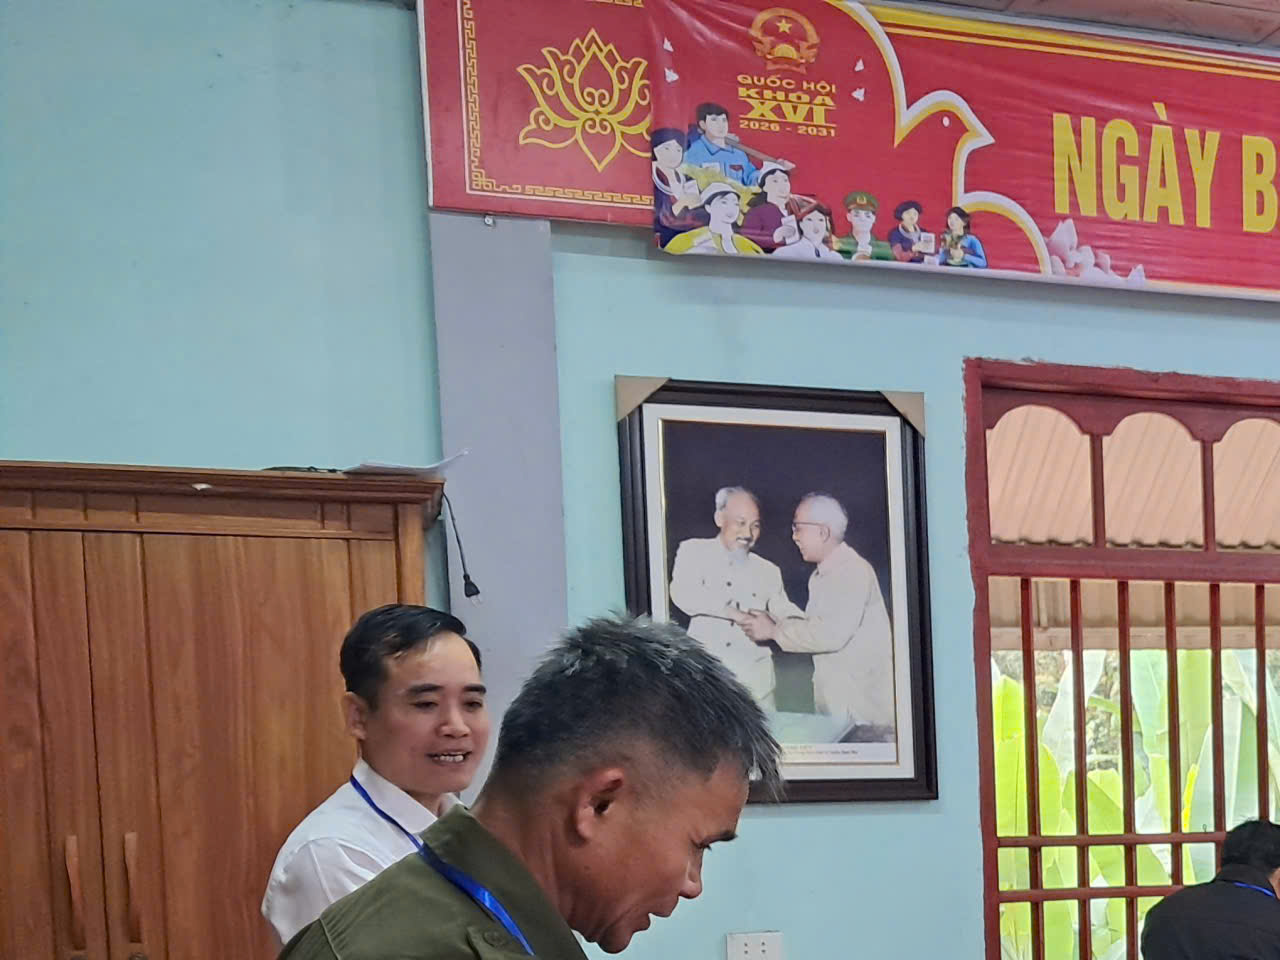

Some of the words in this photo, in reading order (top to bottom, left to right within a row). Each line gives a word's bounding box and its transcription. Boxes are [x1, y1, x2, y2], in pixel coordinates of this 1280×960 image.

[737, 74, 796, 89] QUỐC
[802, 80, 836, 95] HỘI
[745, 99, 827, 125] XVI
[740, 119, 780, 132] 2026
[797, 125, 836, 137] 2031
[1052, 101, 1221, 228] NGÀY
